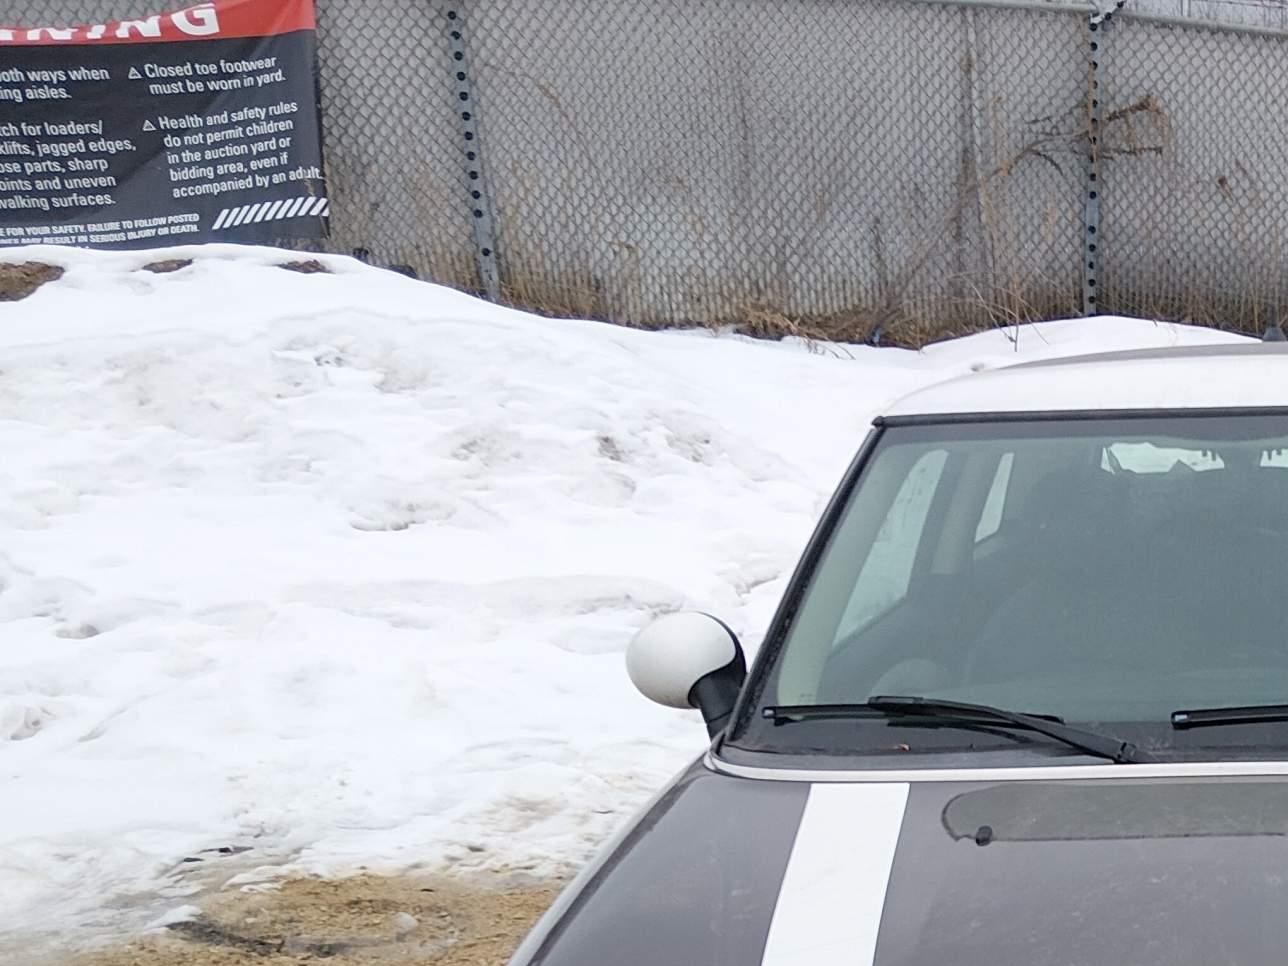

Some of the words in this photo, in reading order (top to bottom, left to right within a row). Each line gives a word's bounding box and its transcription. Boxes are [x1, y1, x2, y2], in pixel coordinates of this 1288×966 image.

[0, 67, 25, 82] oth
[27, 70, 67, 84] ways
[68, 66, 110, 80] when
[144, 62, 193, 78] Closed
[194, 63, 218, 75] toe
[219, 57, 277, 73] footwear
[149, 82, 185, 95] must
[186, 79, 204, 92] be
[206, 78, 241, 91] worn
[243, 75, 255, 87] in
[256, 69, 286, 87] yard.
[25, 85, 72, 99] aisles.
[158, 113, 203, 130] Health
[206, 111, 229, 126] and
[230, 106, 266, 123] safety
[268, 101, 298, 116] rules
[0, 123, 20, 136] ch
[21, 122, 42, 136] for
[163, 133, 181, 148] do
[183, 132, 204, 145] not
[206, 126, 245, 143] permit
[246, 119, 293, 137] children
[35, 139, 86, 157] jagged
[88, 138, 136, 154] edges,
[167, 151, 179, 165] in
[181, 148, 201, 162] the
[204, 142, 248, 160] auction
[249, 138, 277, 156] yard
[278, 136, 292, 148] or
[24, 161, 66, 175] parts,
[67, 158, 109, 172] sharp
[169, 165, 214, 182] bidding
[216, 161, 248, 175] area,
[250, 156, 278, 171] even
[280, 151, 289, 166] if
[35, 176, 62, 190] and
[64, 176, 117, 189] uneven
[172, 173, 253, 198] accompanied
[255, 173, 270, 188] by
[272, 169, 287, 184] an
[51, 193, 116, 207] surfaces.
[121, 220, 133, 229] TO
[134, 217, 167, 228] FOLLOW
[167, 213, 200, 224] POSTED
